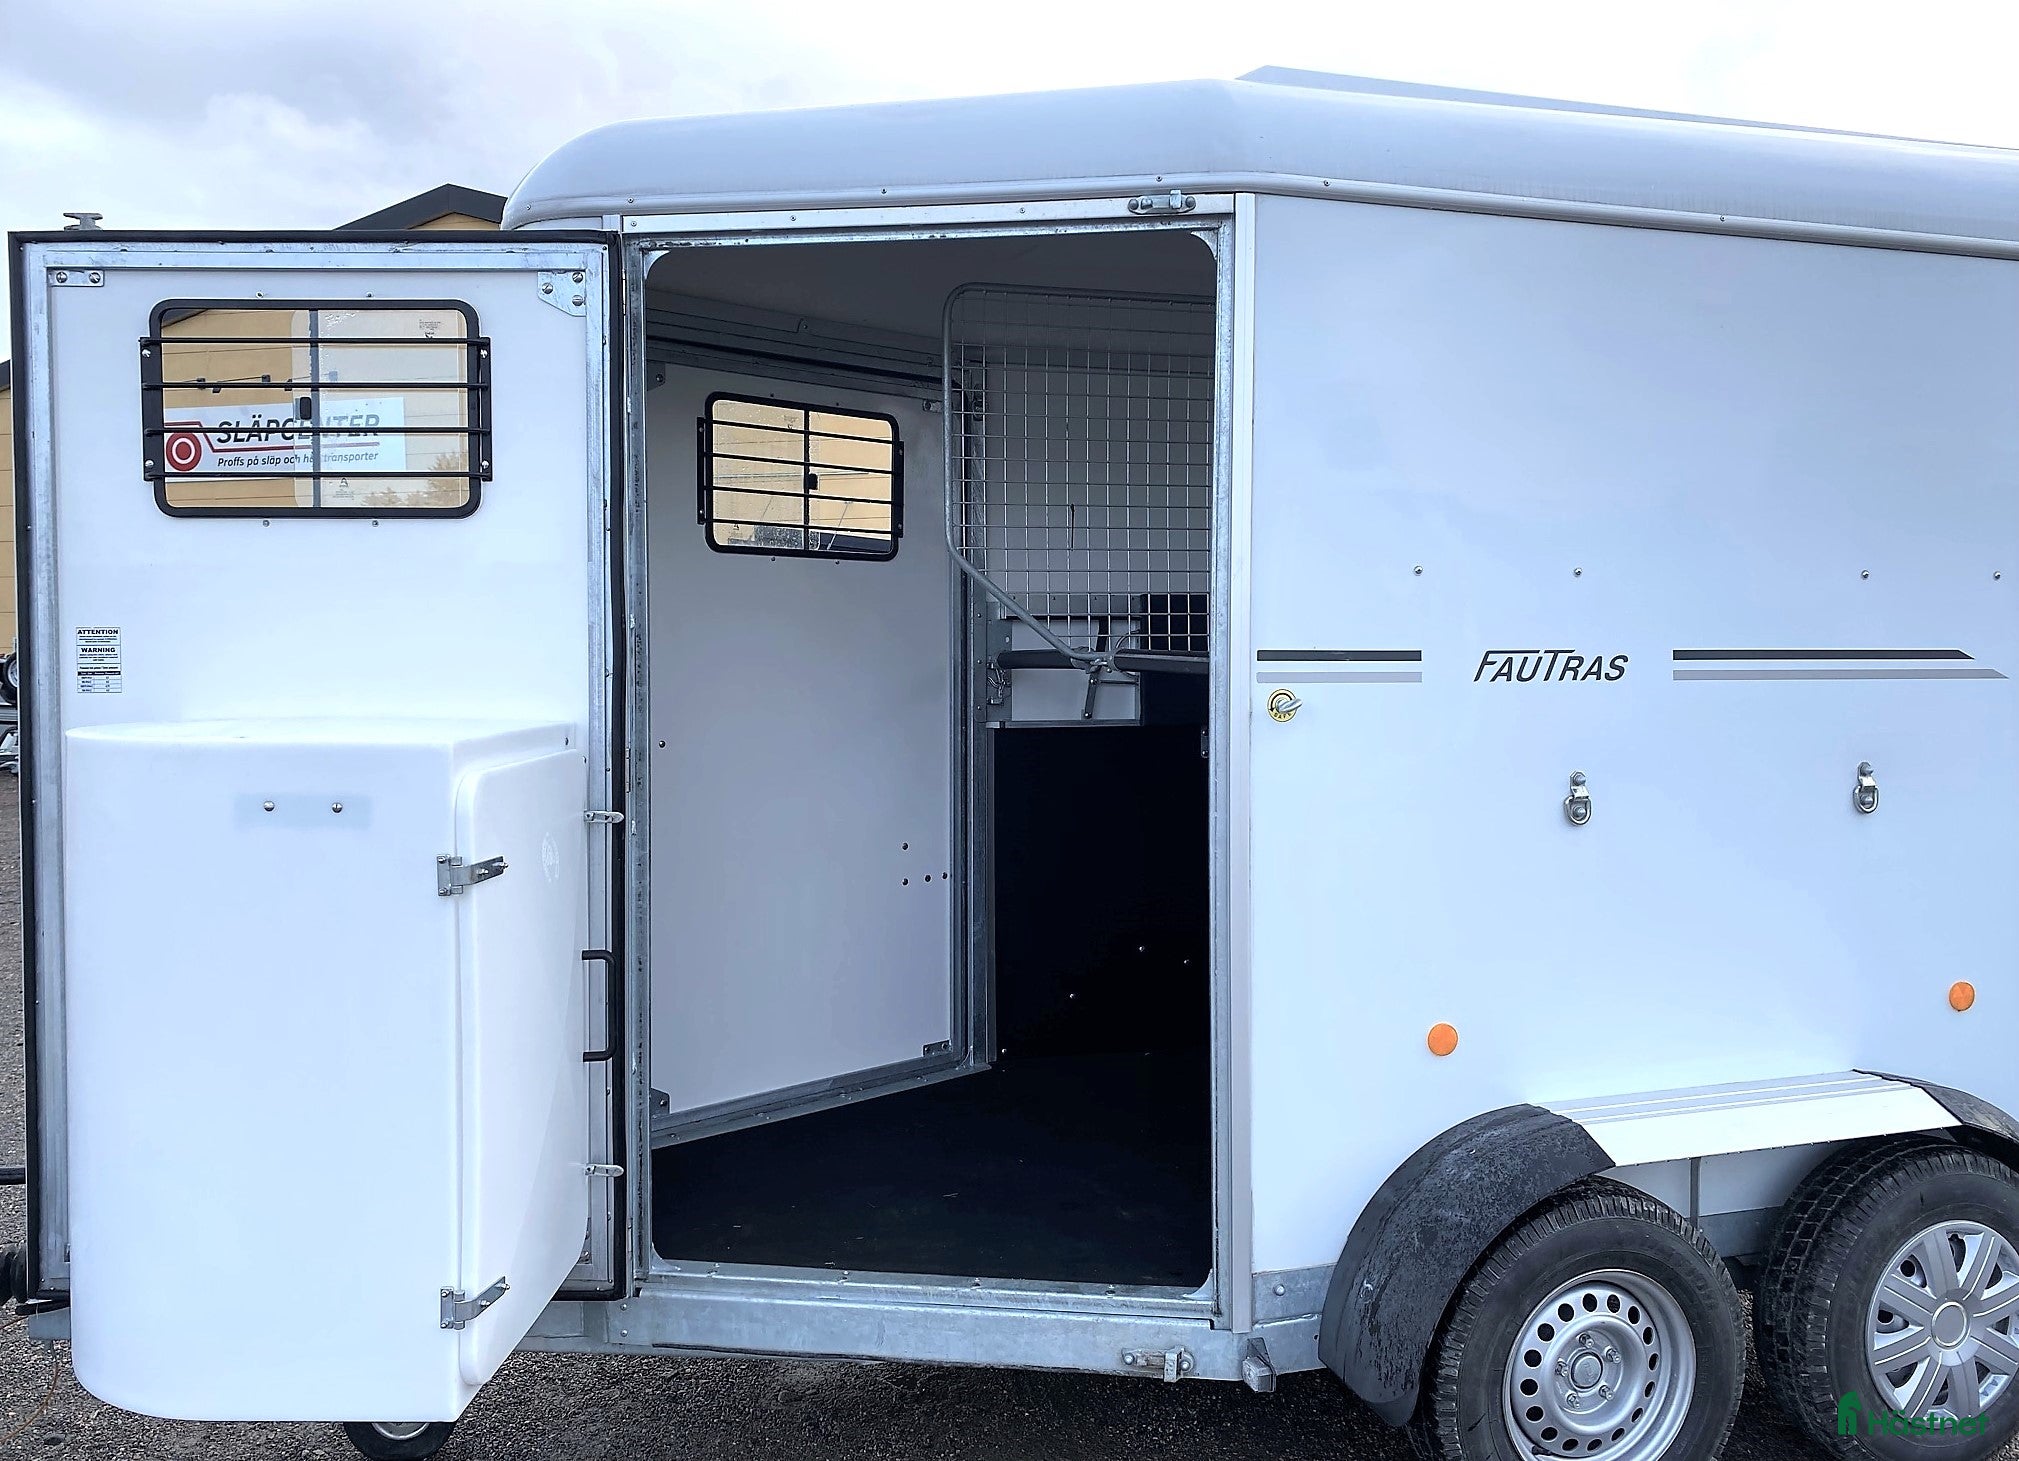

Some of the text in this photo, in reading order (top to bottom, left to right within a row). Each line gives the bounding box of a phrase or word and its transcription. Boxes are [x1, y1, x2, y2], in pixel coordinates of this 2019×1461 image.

[217, 456, 245, 467] Proffs
[247, 455, 259, 468] på
[262, 455, 281, 467] släp
[284, 454, 300, 464] och
[1473, 649, 1629, 683] FAUTRAS
